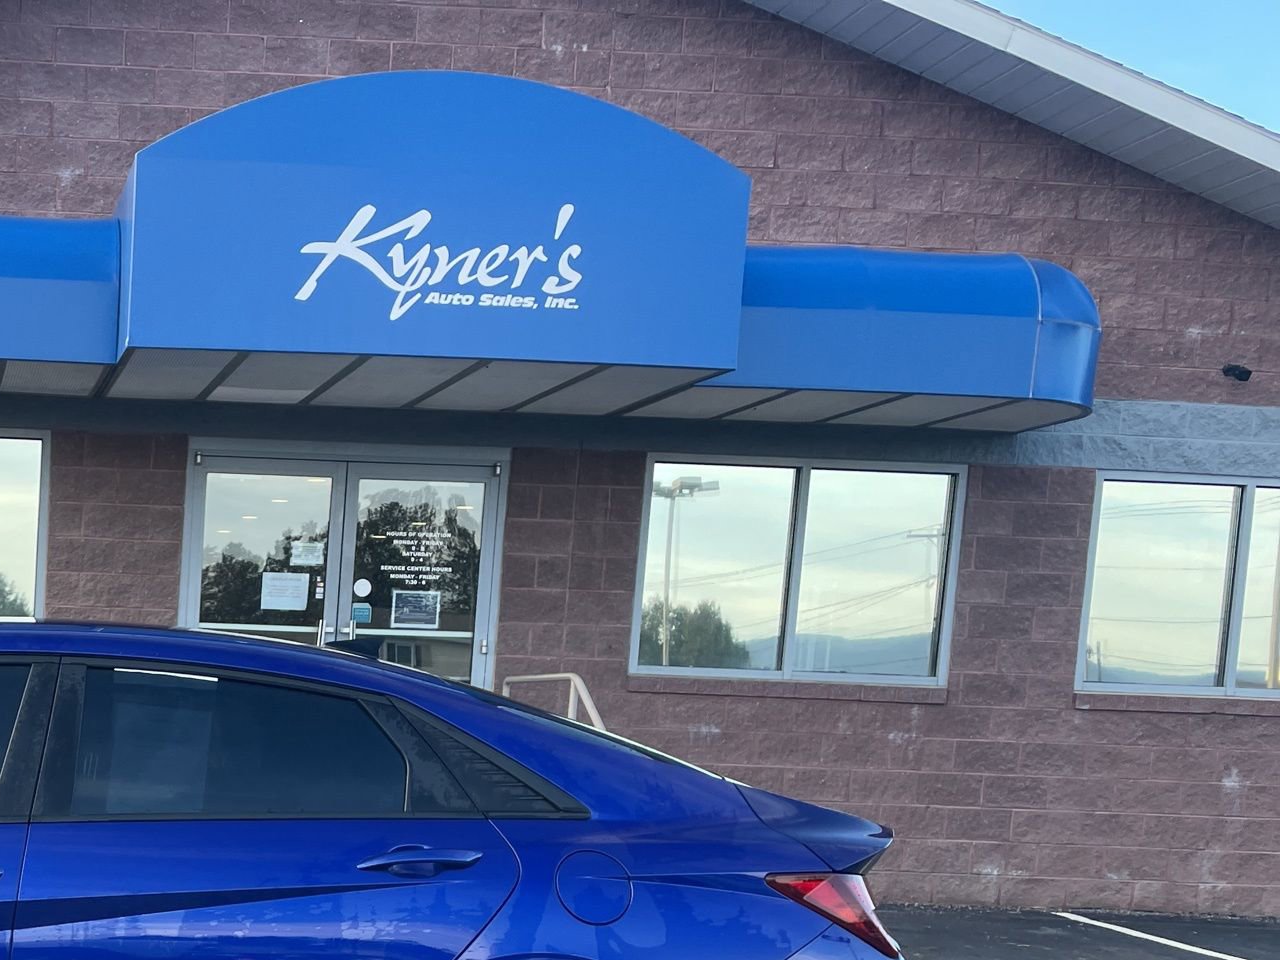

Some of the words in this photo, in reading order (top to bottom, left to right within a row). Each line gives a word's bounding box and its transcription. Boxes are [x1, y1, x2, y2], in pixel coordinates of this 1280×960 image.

[293, 203, 583, 321] Kyner's
[423, 291, 475, 306] Auto
[478, 293, 539, 309] Sales,
[544, 295, 580, 309] Inc.
